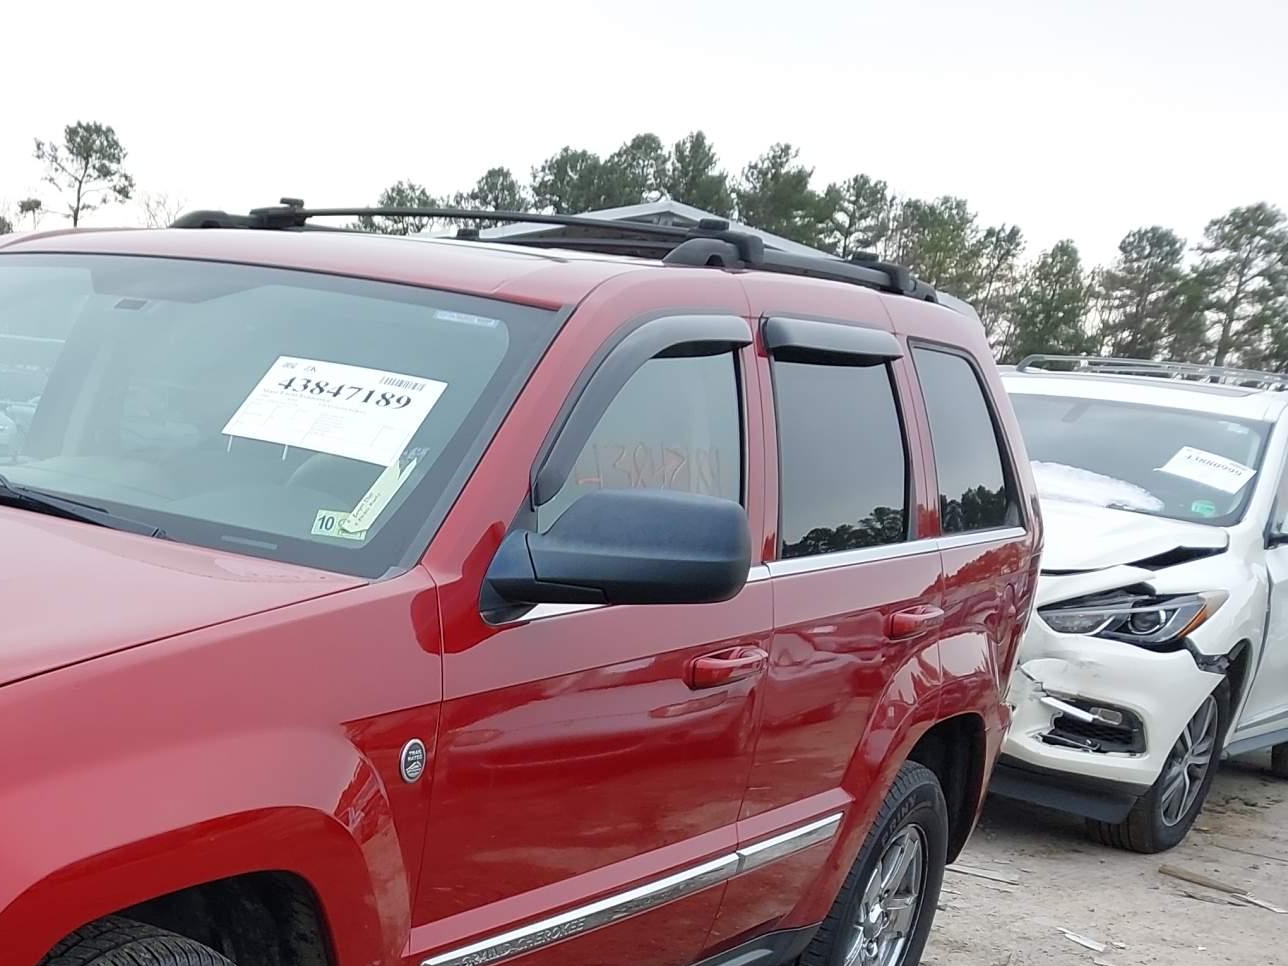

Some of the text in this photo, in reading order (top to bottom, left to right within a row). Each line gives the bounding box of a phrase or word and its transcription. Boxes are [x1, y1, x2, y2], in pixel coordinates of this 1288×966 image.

[278, 377, 412, 409] 43847189
[318, 515, 335, 531] 10
[513, 918, 585, 952] CHEROKEE
